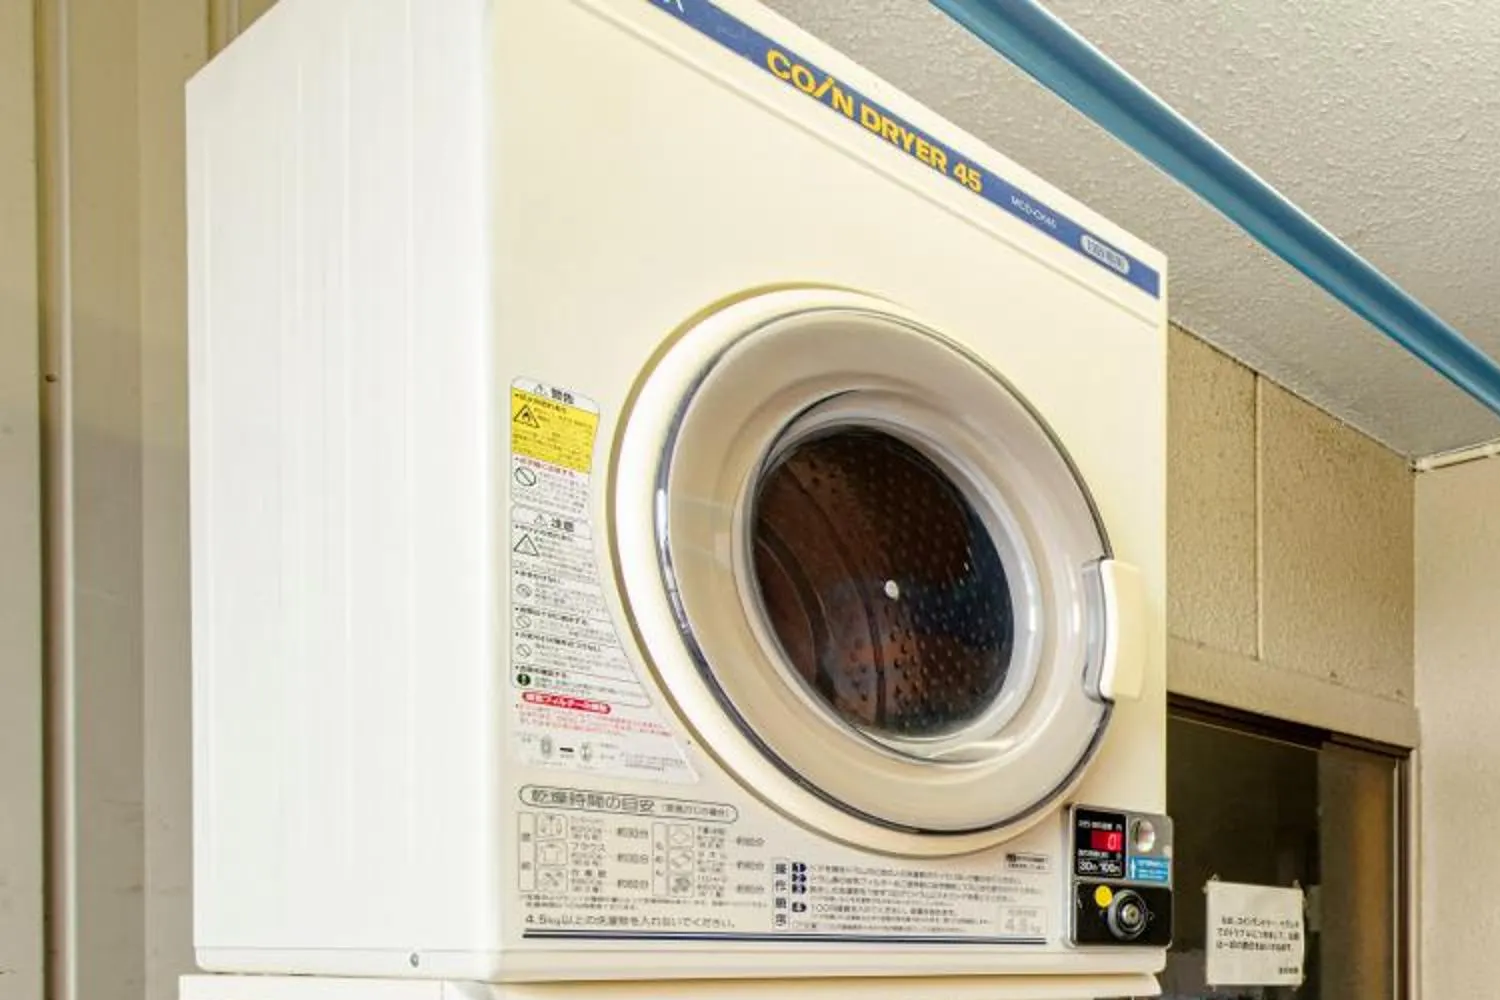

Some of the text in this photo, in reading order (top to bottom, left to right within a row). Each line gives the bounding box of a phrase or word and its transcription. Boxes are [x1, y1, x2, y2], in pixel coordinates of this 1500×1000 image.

[766, 48, 853, 119] COIN
[860, 103, 947, 174] DRYER
[953, 162, 984, 194] 45
